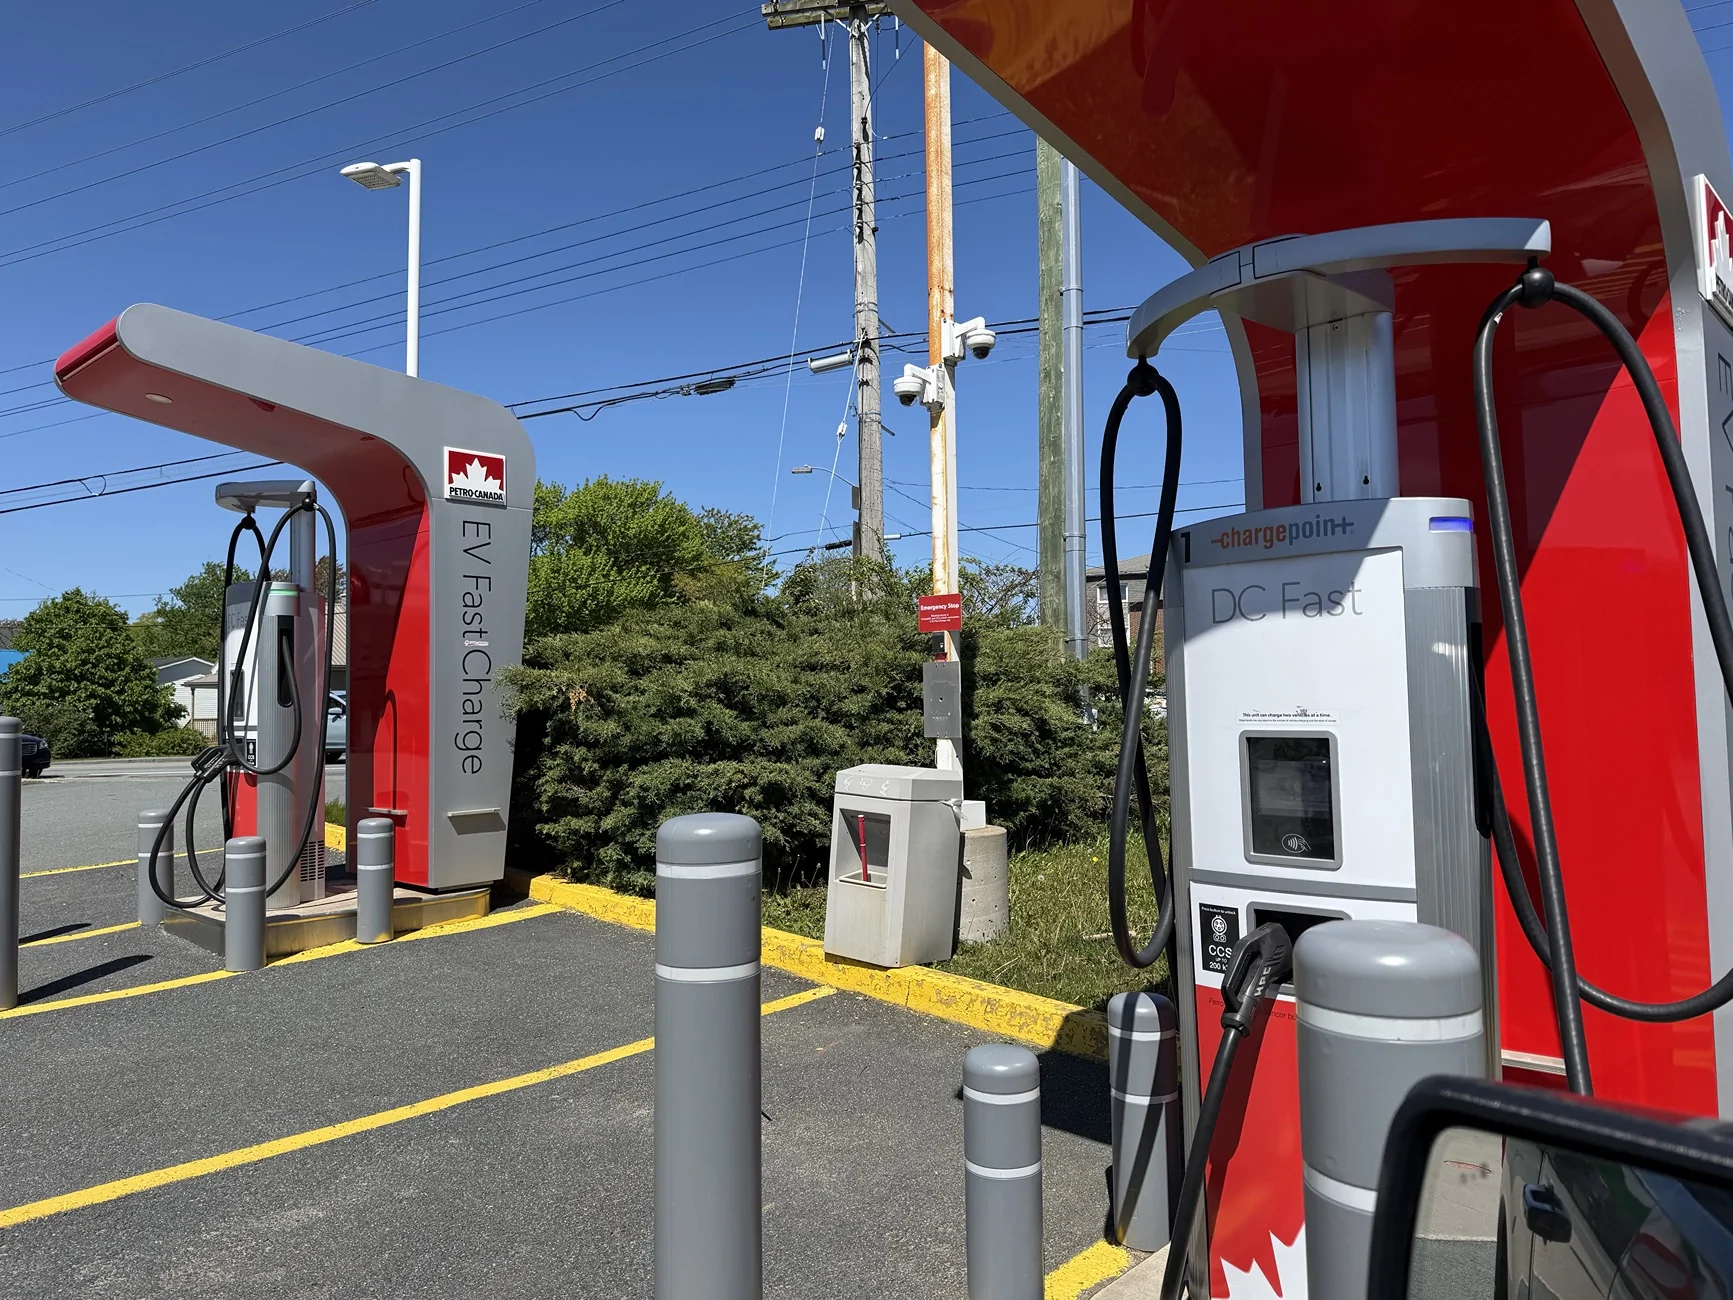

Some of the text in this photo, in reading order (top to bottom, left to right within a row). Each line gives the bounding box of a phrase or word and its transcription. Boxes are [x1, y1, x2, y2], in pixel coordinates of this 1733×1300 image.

[449, 486, 504, 501] PETRO-CANADA
[462, 520, 491, 565] EV
[1180, 531, 1191, 564] 1
[462, 574, 491, 639] Fast
[1211, 580, 1364, 625] DC Fast
[454, 649, 492, 774] Charge
[1208, 944, 1233, 959] CCS
[1209, 961, 1221, 970] 200
[1209, 997, 1224, 1007] Petro
